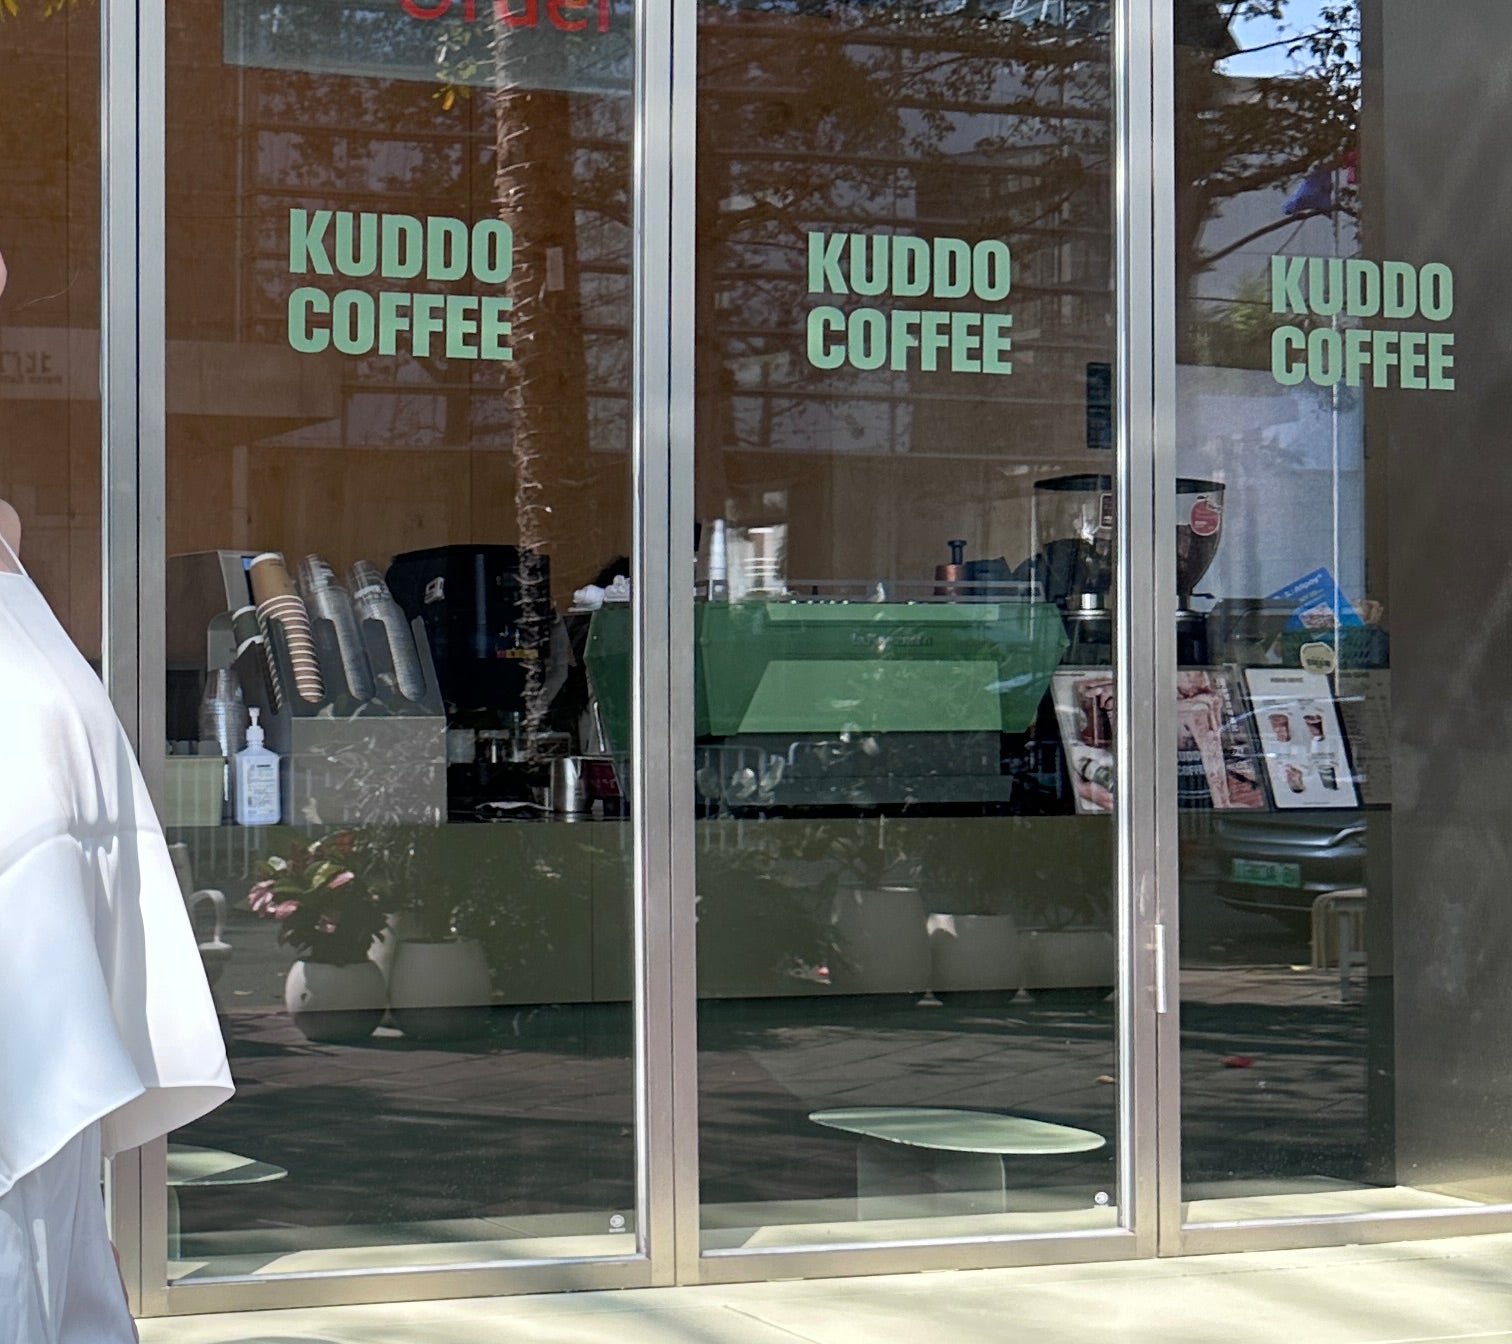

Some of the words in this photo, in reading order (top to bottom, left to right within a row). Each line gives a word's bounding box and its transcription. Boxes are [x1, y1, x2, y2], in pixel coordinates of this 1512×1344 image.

[289, 208, 513, 283] KUDDO
[807, 231, 1012, 301] KUDDO
[1271, 254, 1454, 321] KUDDO
[288, 287, 513, 360] COFFEE
[807, 306, 1013, 374] COFFEE
[1271, 325, 1454, 390] COFFEE
